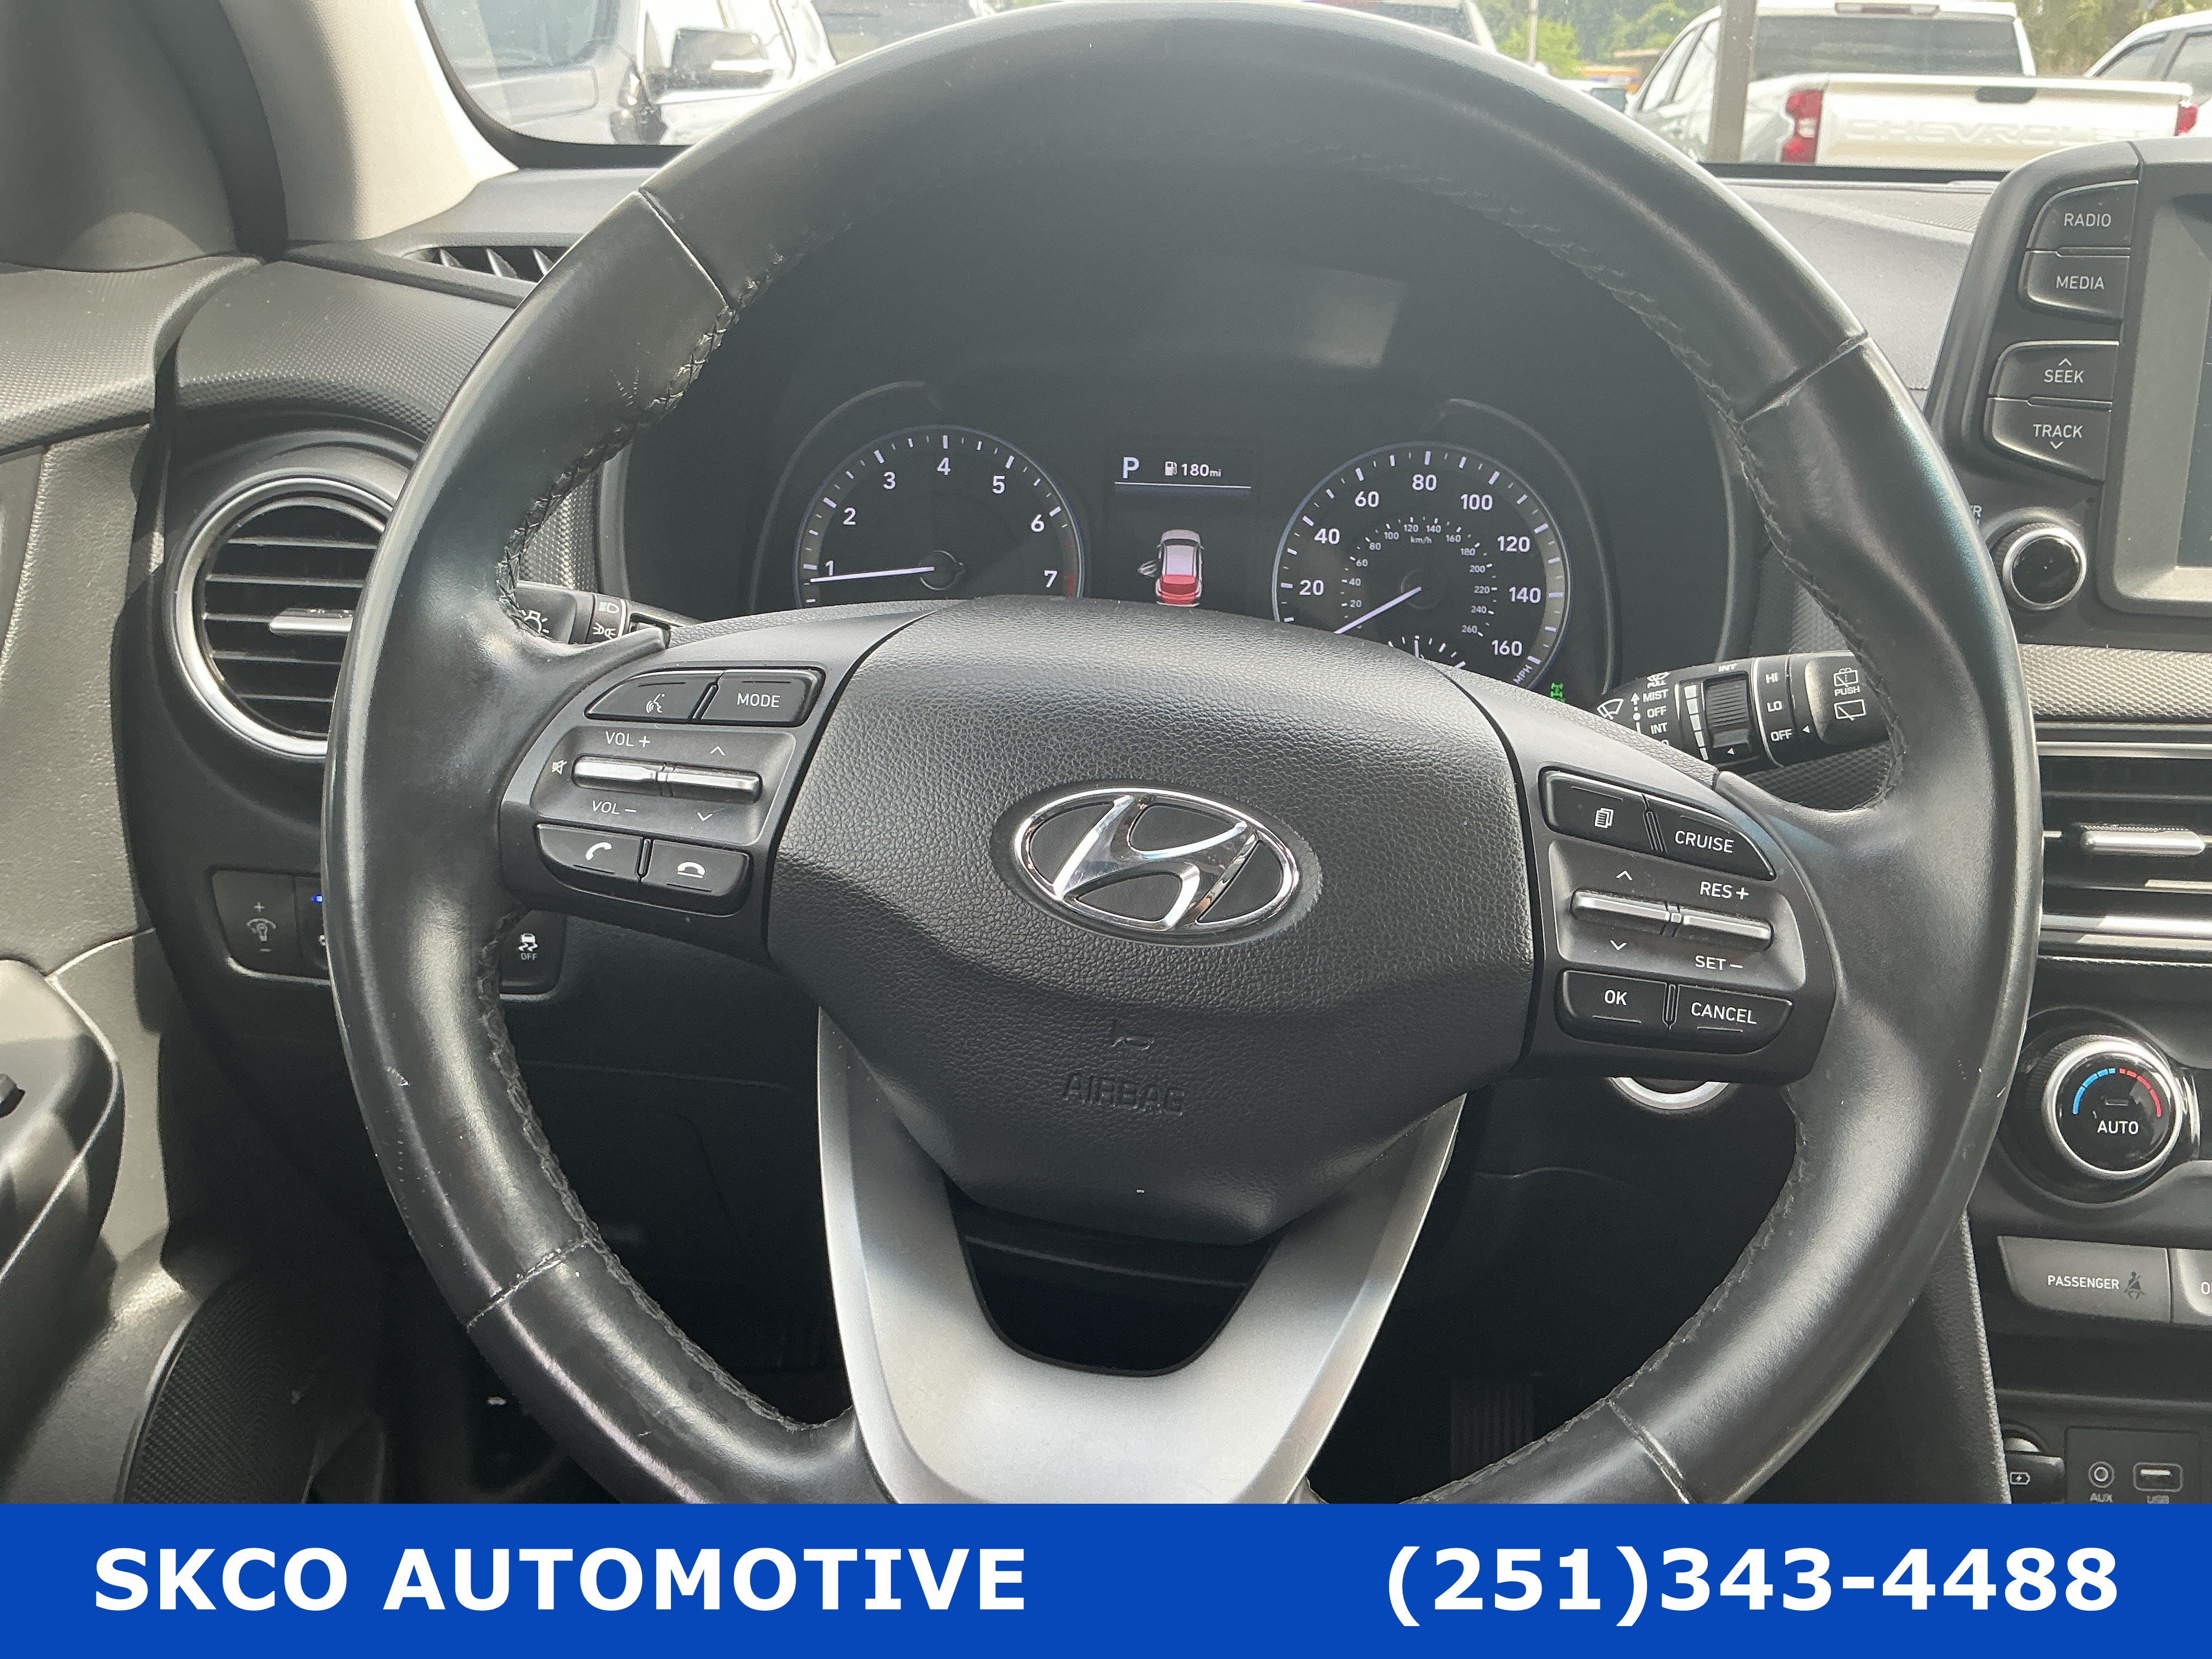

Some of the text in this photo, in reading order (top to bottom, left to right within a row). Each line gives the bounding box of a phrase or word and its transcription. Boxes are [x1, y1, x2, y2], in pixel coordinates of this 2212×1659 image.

[2064, 213, 2111, 227] RADIO
[2057, 276, 2104, 289] MEDIA
[2044, 369, 2084, 383] SEEK
[2033, 424, 2083, 438] TRACK
[937, 458, 950, 475] 4
[1123, 457, 1139, 478] P
[883, 472, 895, 489] 3
[992, 476, 1005, 493] 5
[1412, 475, 1436, 490] 80
[1355, 492, 1379, 507] 60
[1461, 494, 1492, 510] 100
[843, 508, 855, 524] 2
[1031, 515, 1044, 532] 6
[1314, 528, 1340, 544] 40
[1384, 532, 1399, 540] 100
[1498, 536, 1530, 552] 120
[825, 561, 834, 576] 1
[1356, 558, 1369, 567] 60
[1045, 570, 1057, 588] 7
[1300, 580, 1324, 595] 20
[1509, 587, 1541, 603] 140
[1461, 625, 1477, 633] 260
[1492, 640, 1522, 656] 160
[1513, 664, 1533, 685] MPH
[1718, 663, 1738, 673] INT
[1766, 673, 1778, 684] HI
[1642, 689, 1669, 703] MIST
[1834, 685, 1861, 697] PUSH
[737, 693, 780, 707] MODE
[1767, 701, 1782, 712] LO
[1646, 705, 1667, 719] OFF
[1650, 722, 1668, 735] INT
[1771, 729, 1792, 741] OFF
[606, 731, 634, 746] VOL
[592, 800, 620, 815] VOL
[1675, 831, 1734, 853] CRUISE
[1700, 882, 1732, 898] RES
[521, 952, 538, 961] OFF
[1695, 955, 1726, 970] SET
[1605, 990, 1627, 1005] OK
[1691, 1002, 1757, 1024] CANCEL
[1062, 1073, 1186, 1117] AIRBAG
[2097, 1120, 2138, 1134] AUTO
[2048, 1276, 2119, 1289] PASSENGER
[2089, 1492, 2113, 1504] AUX
